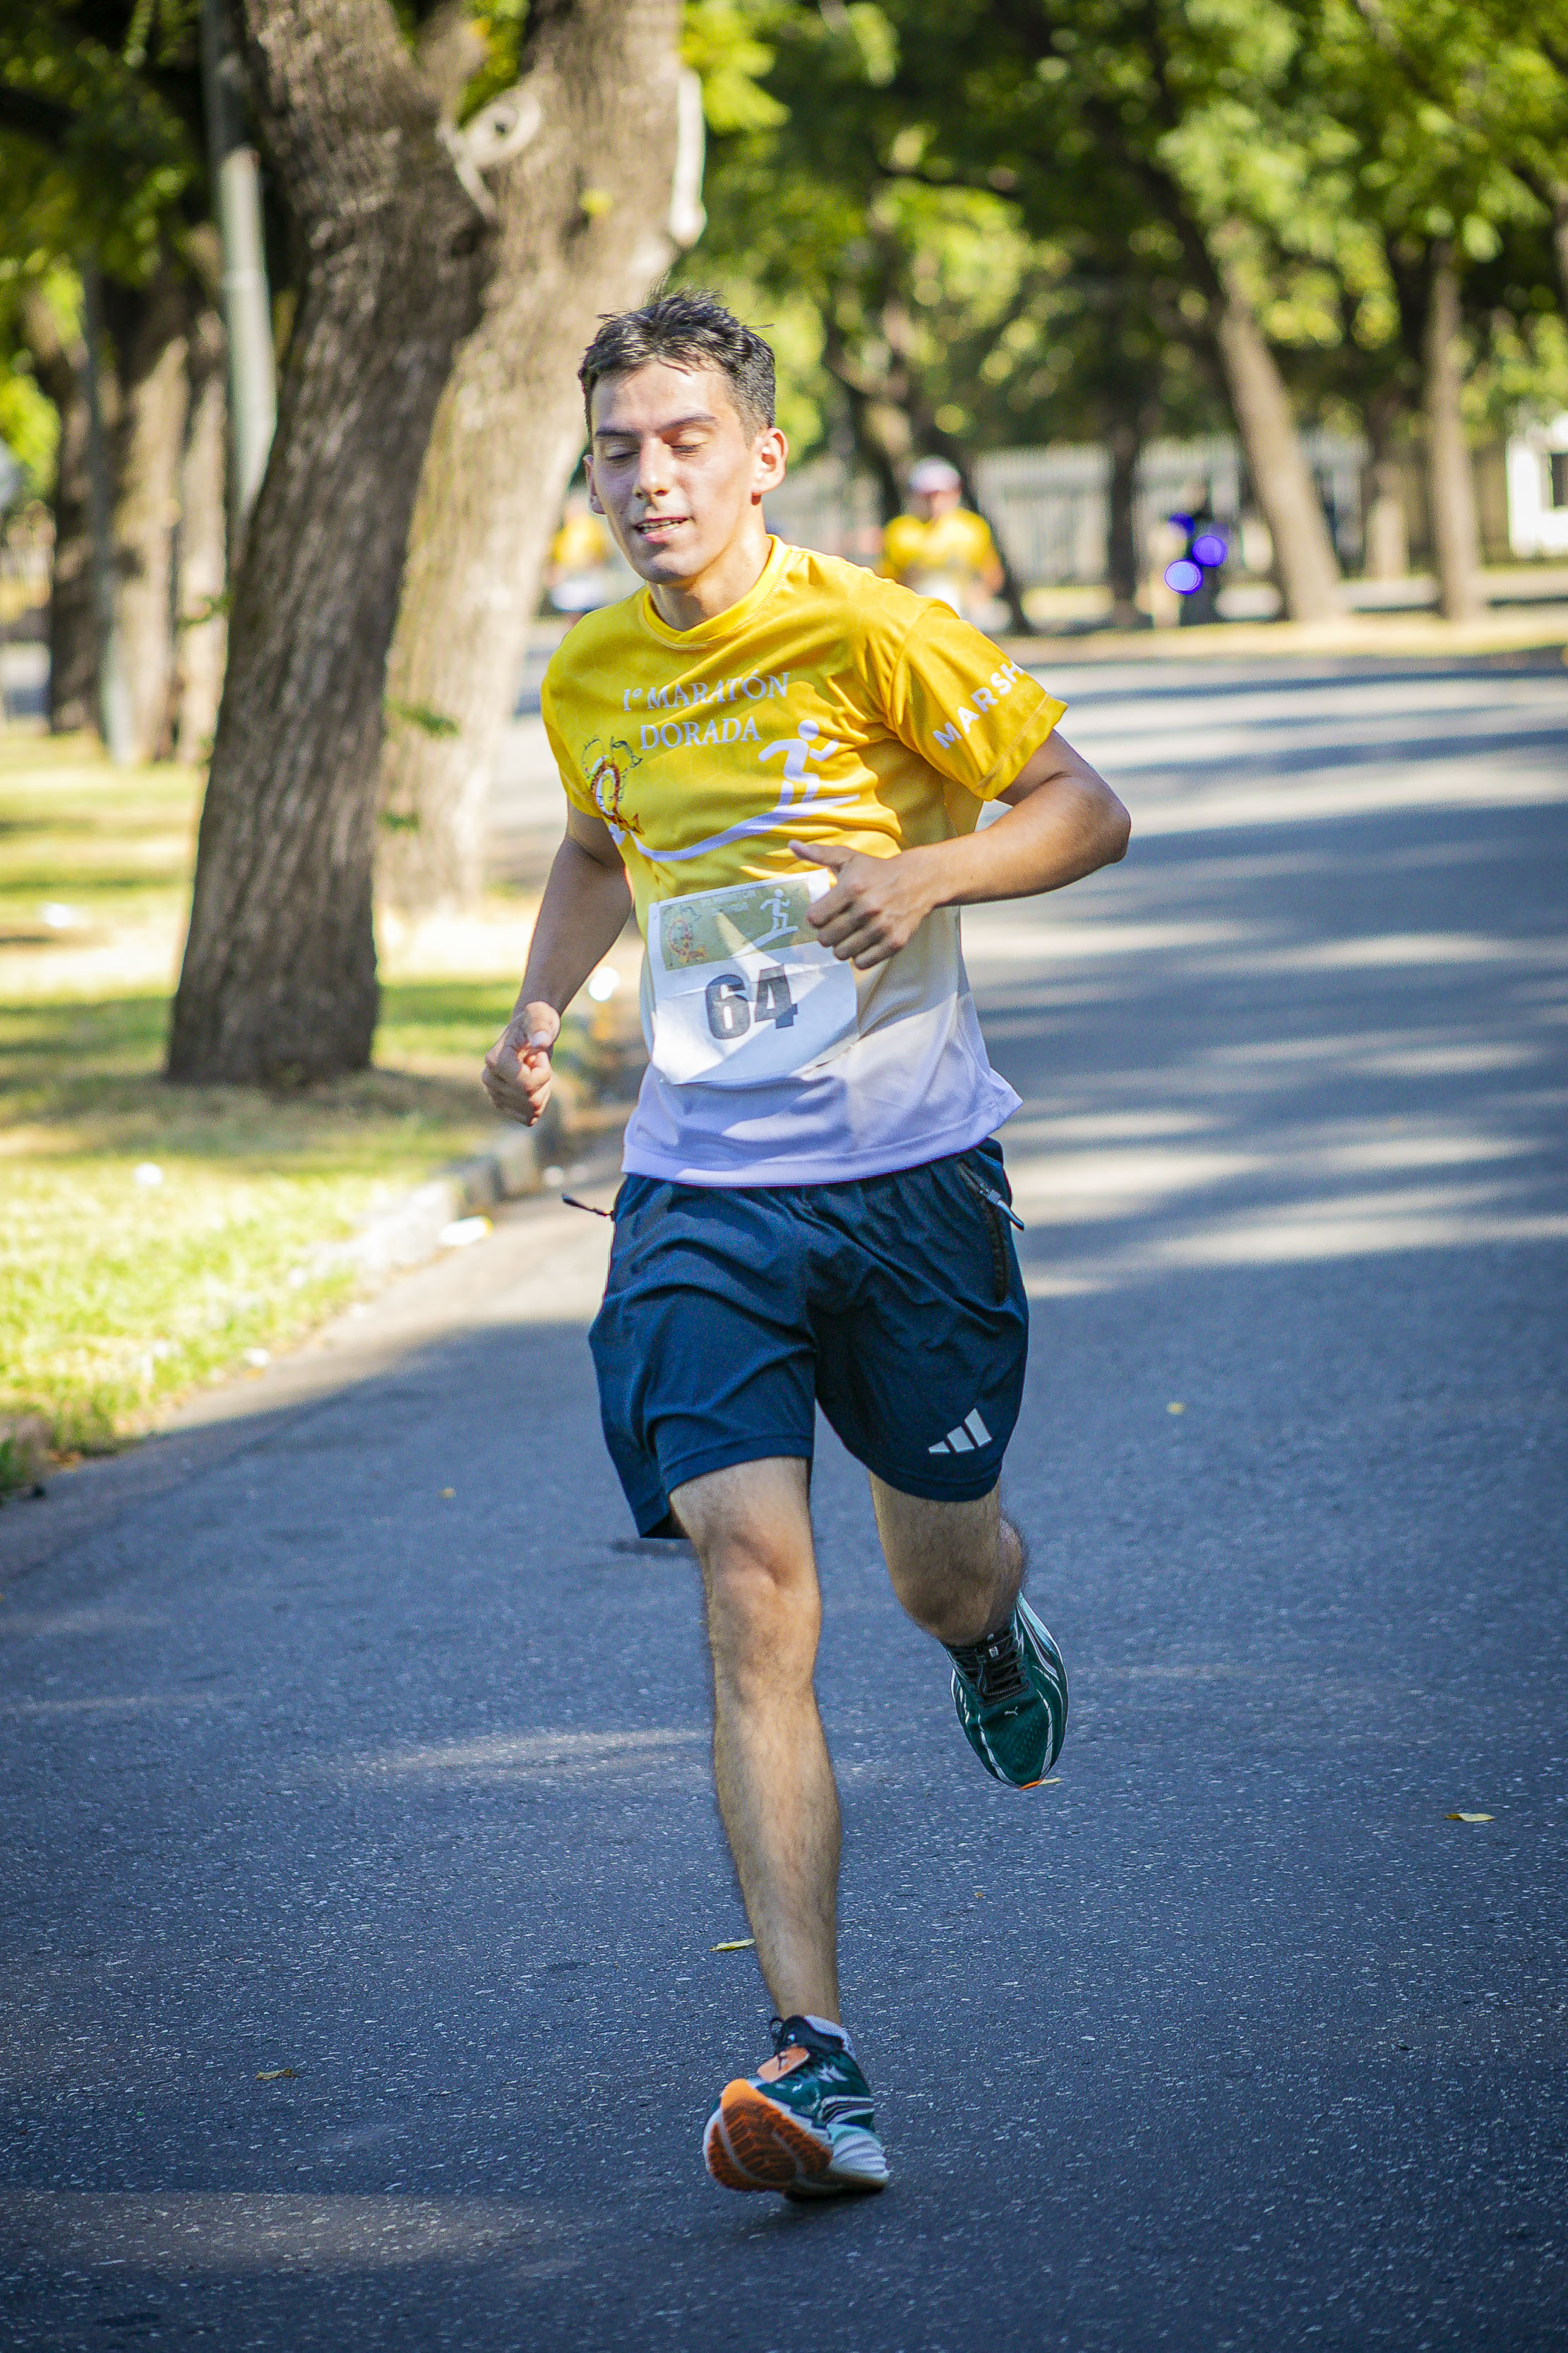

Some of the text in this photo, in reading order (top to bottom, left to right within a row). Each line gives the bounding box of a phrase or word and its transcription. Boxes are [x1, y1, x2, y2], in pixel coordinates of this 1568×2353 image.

[647, 669, 791, 710] MARATÓN
[640, 715, 762, 750] DORADA
[705, 964, 798, 1040] 64
